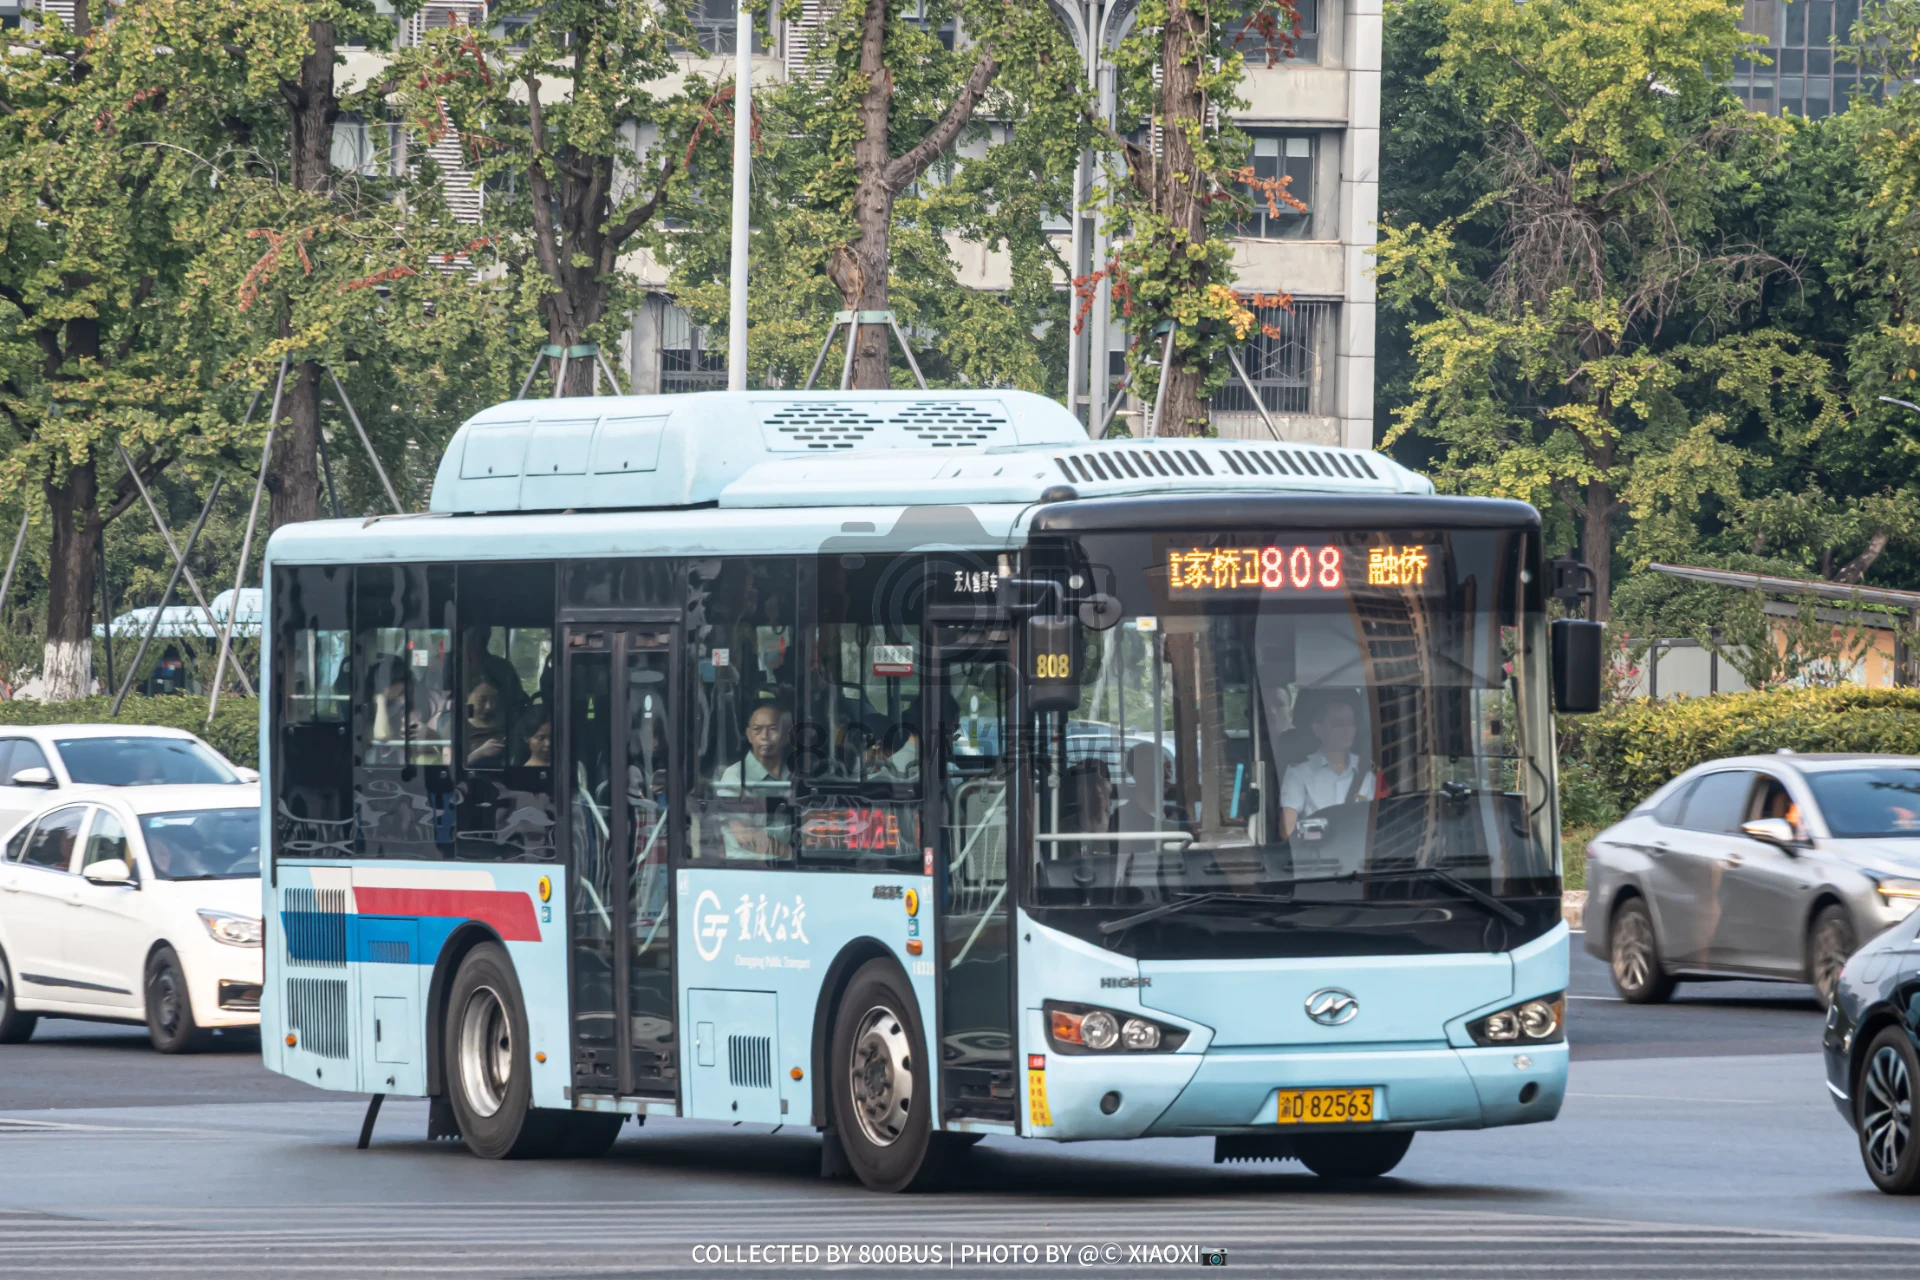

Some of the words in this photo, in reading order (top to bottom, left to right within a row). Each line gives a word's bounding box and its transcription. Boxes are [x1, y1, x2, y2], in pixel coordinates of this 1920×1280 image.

[1261, 546, 1340, 588] 808
[1368, 545, 1428, 586] 融侨
[954, 571, 998, 593] 无人售票车
[1037, 654, 1069, 678] 808
[734, 893, 810, 945] 重庆公交
[1100, 976, 1153, 989] HIGER
